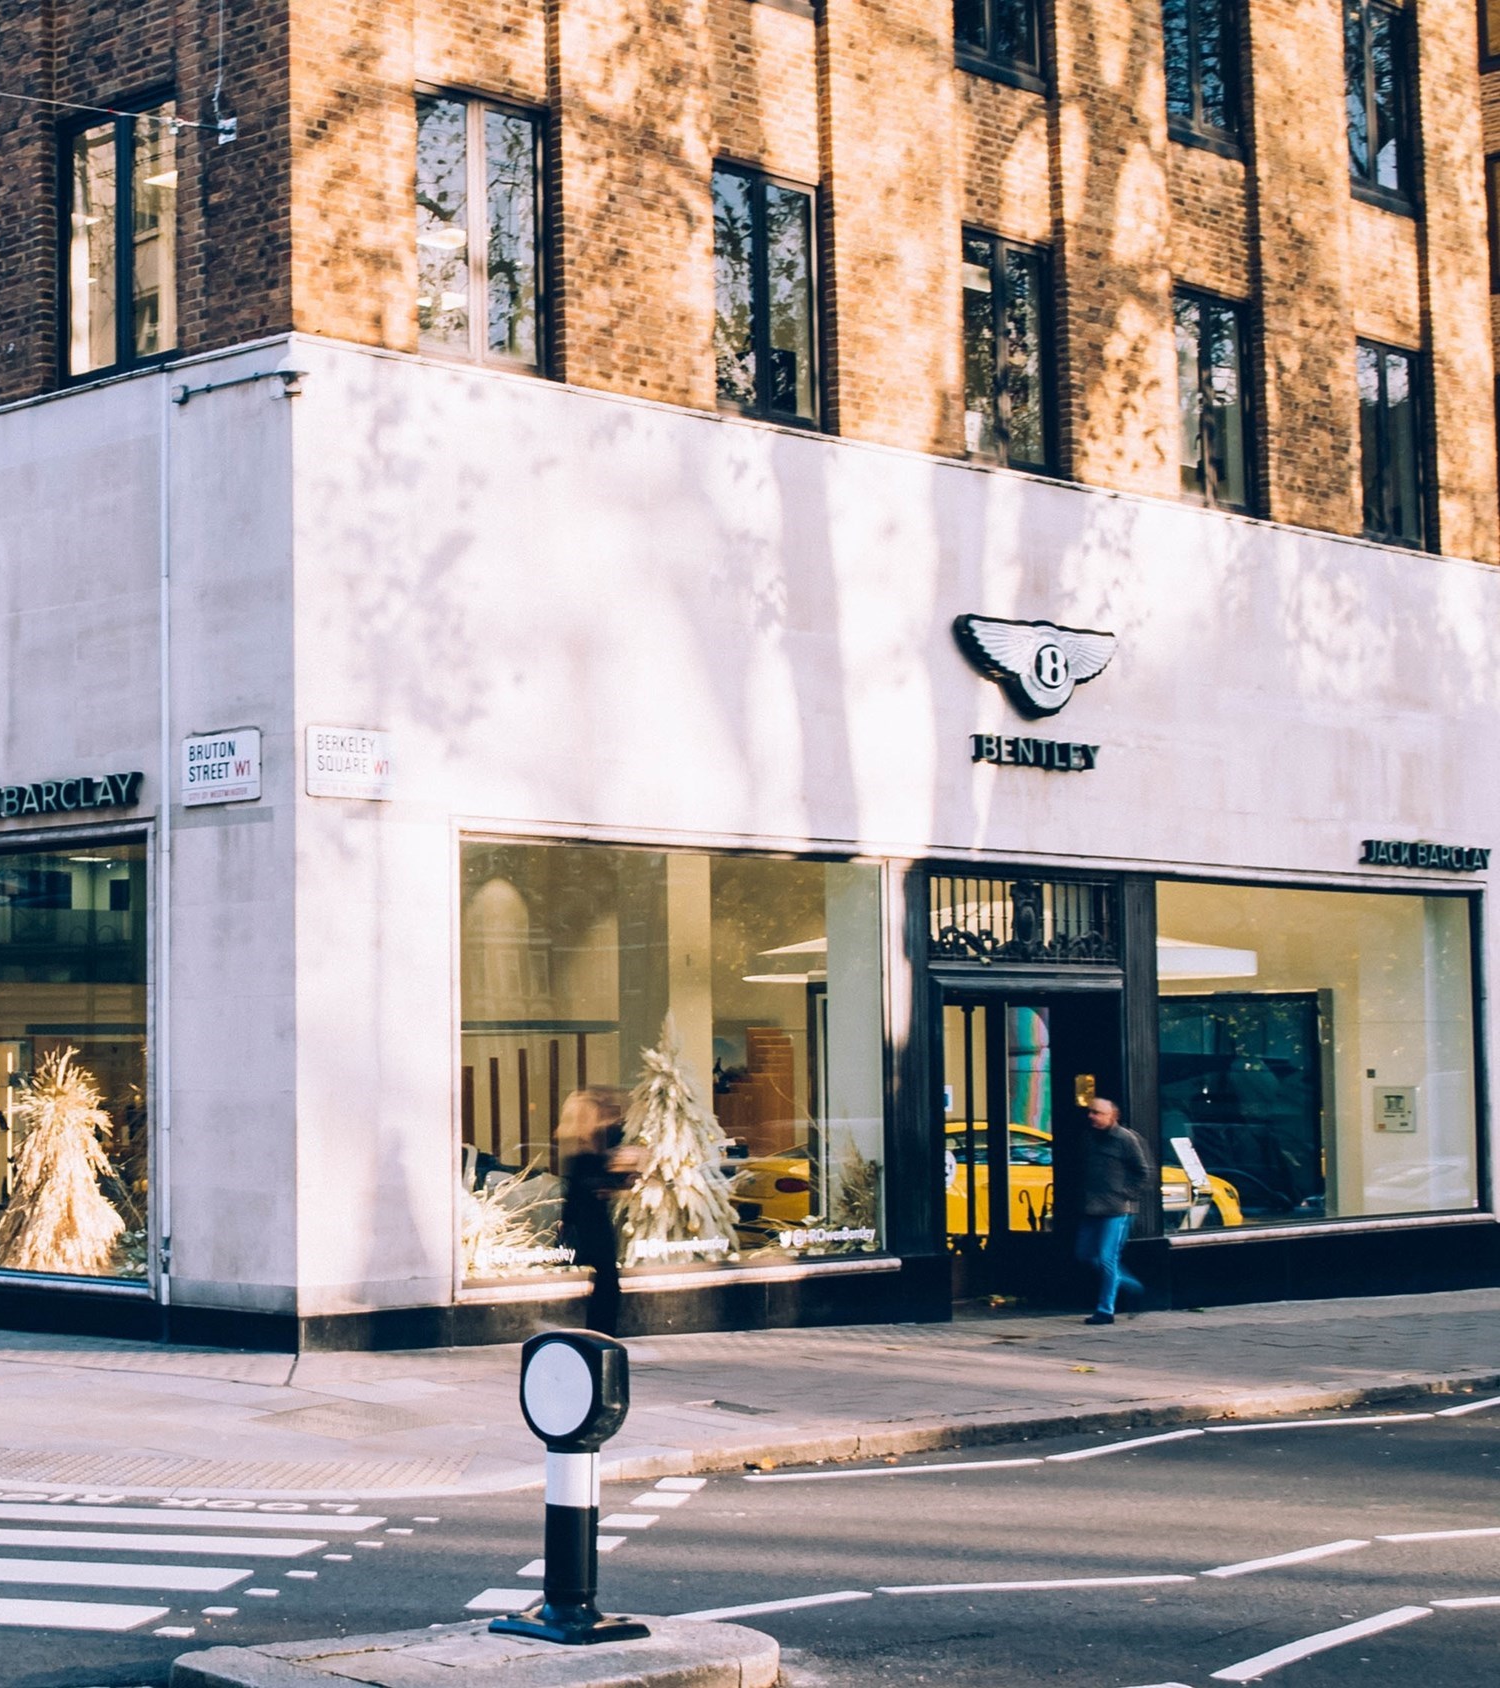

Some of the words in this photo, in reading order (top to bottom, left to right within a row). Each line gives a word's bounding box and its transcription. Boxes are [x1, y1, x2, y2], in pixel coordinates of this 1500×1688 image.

[188, 740, 236, 761] BRUTON
[316, 733, 376, 753] BERKELEY
[978, 734, 1100, 771] BENTLEY
[188, 761, 230, 783] STREET
[234, 759, 250, 777] W1
[317, 754, 368, 774] SQUARE
[373, 759, 389, 776] W1
[1, 772, 137, 817] BARCLAY
[1367, 839, 1413, 866] JACK
[1416, 842, 1491, 870] BARCLAY
[158, 1497, 362, 1514] LOOK
